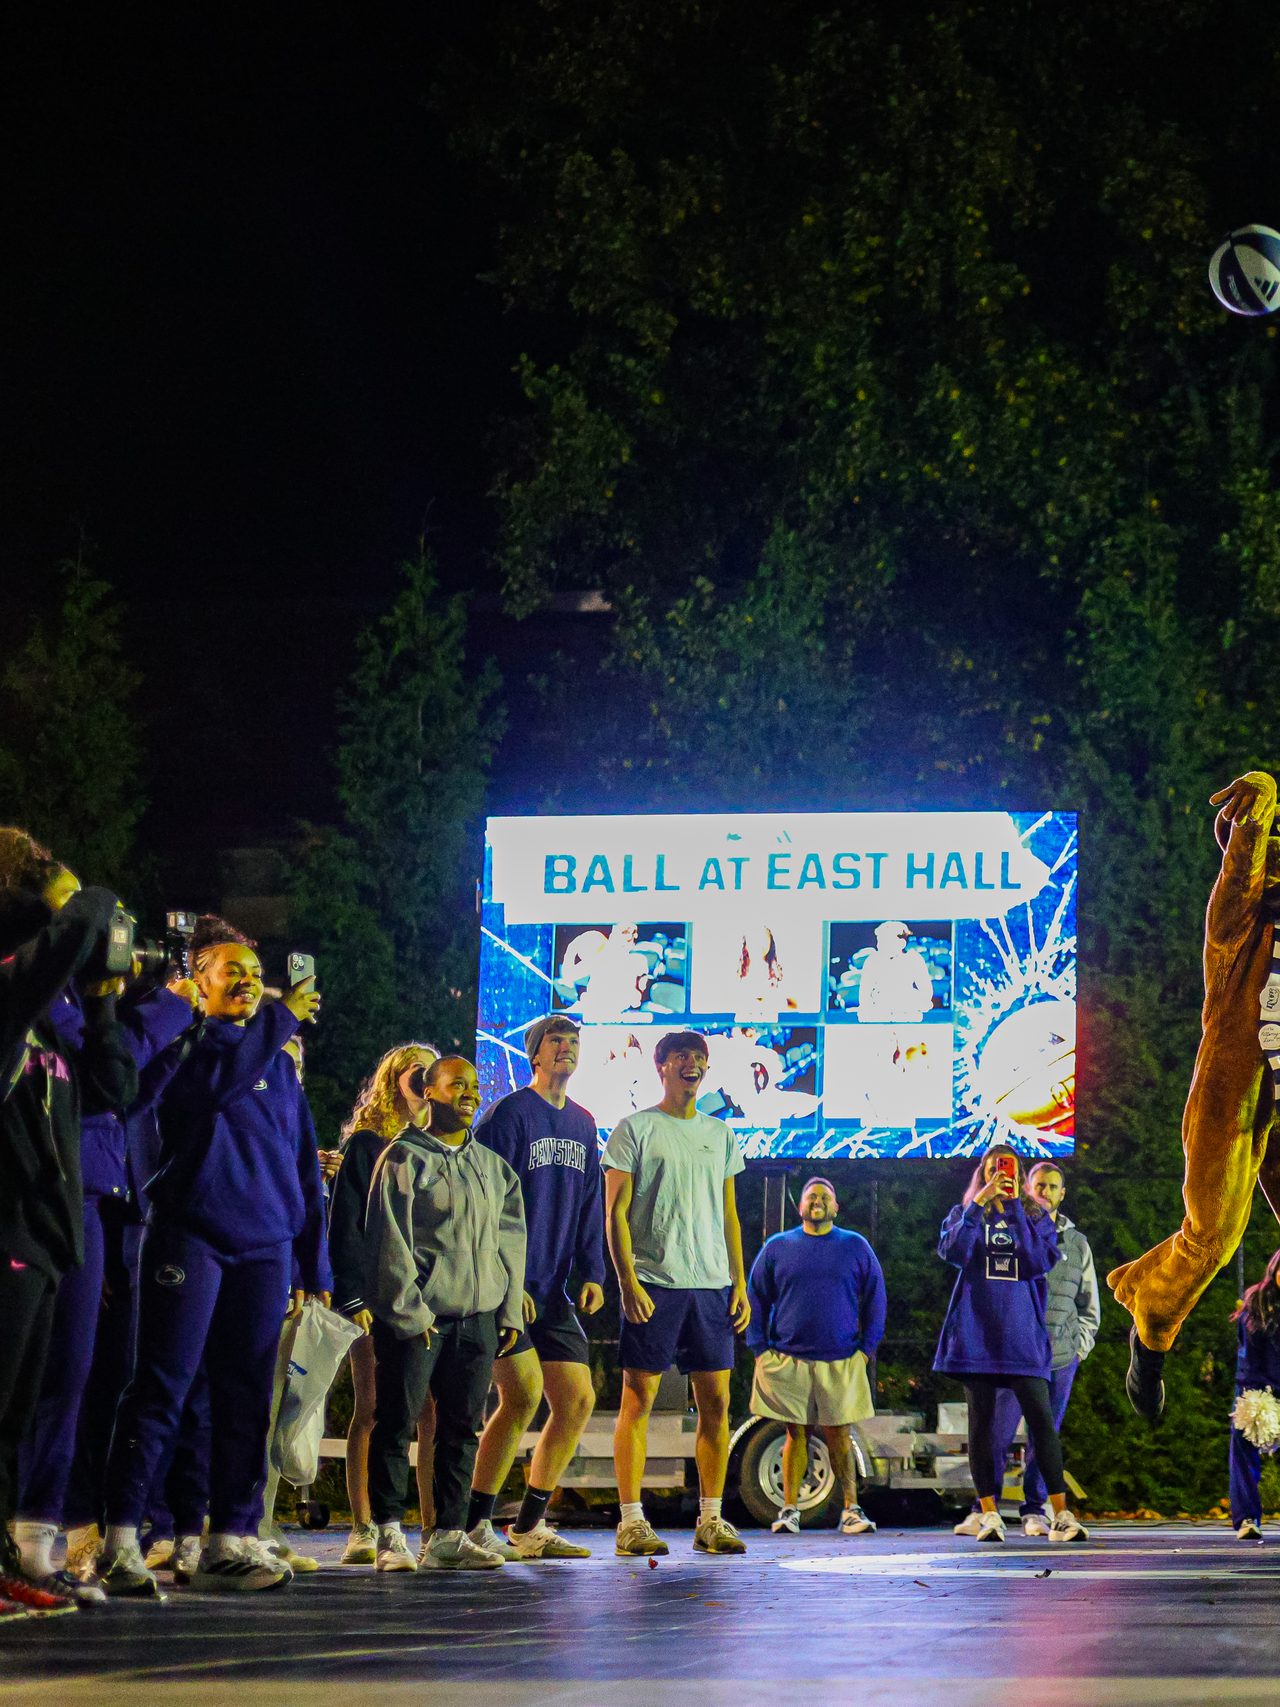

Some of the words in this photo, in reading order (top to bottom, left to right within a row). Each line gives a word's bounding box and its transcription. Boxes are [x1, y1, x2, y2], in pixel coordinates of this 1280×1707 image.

[543, 853, 680, 894] BALL
[698, 857, 750, 891] AT
[766, 852, 889, 890] EAST
[904, 851, 1022, 890] HALL
